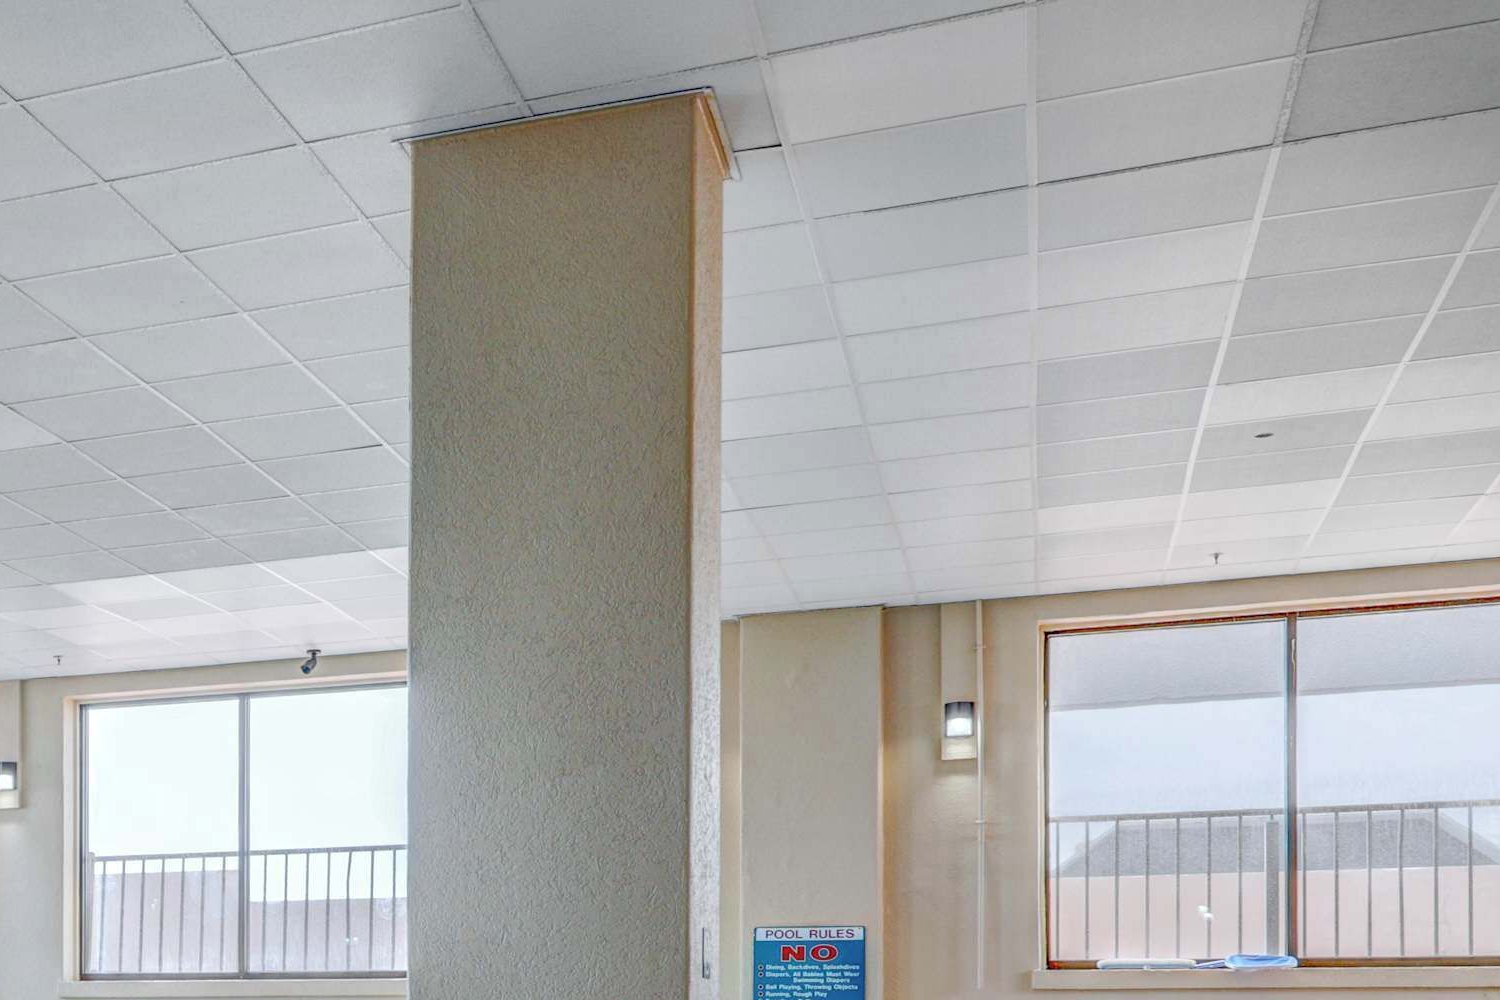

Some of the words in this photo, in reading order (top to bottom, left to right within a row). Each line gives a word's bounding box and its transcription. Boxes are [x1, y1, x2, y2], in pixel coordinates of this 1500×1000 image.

[765, 929, 803, 939] POOL
[809, 928, 855, 939] RULES
[780, 943, 839, 963] NO
